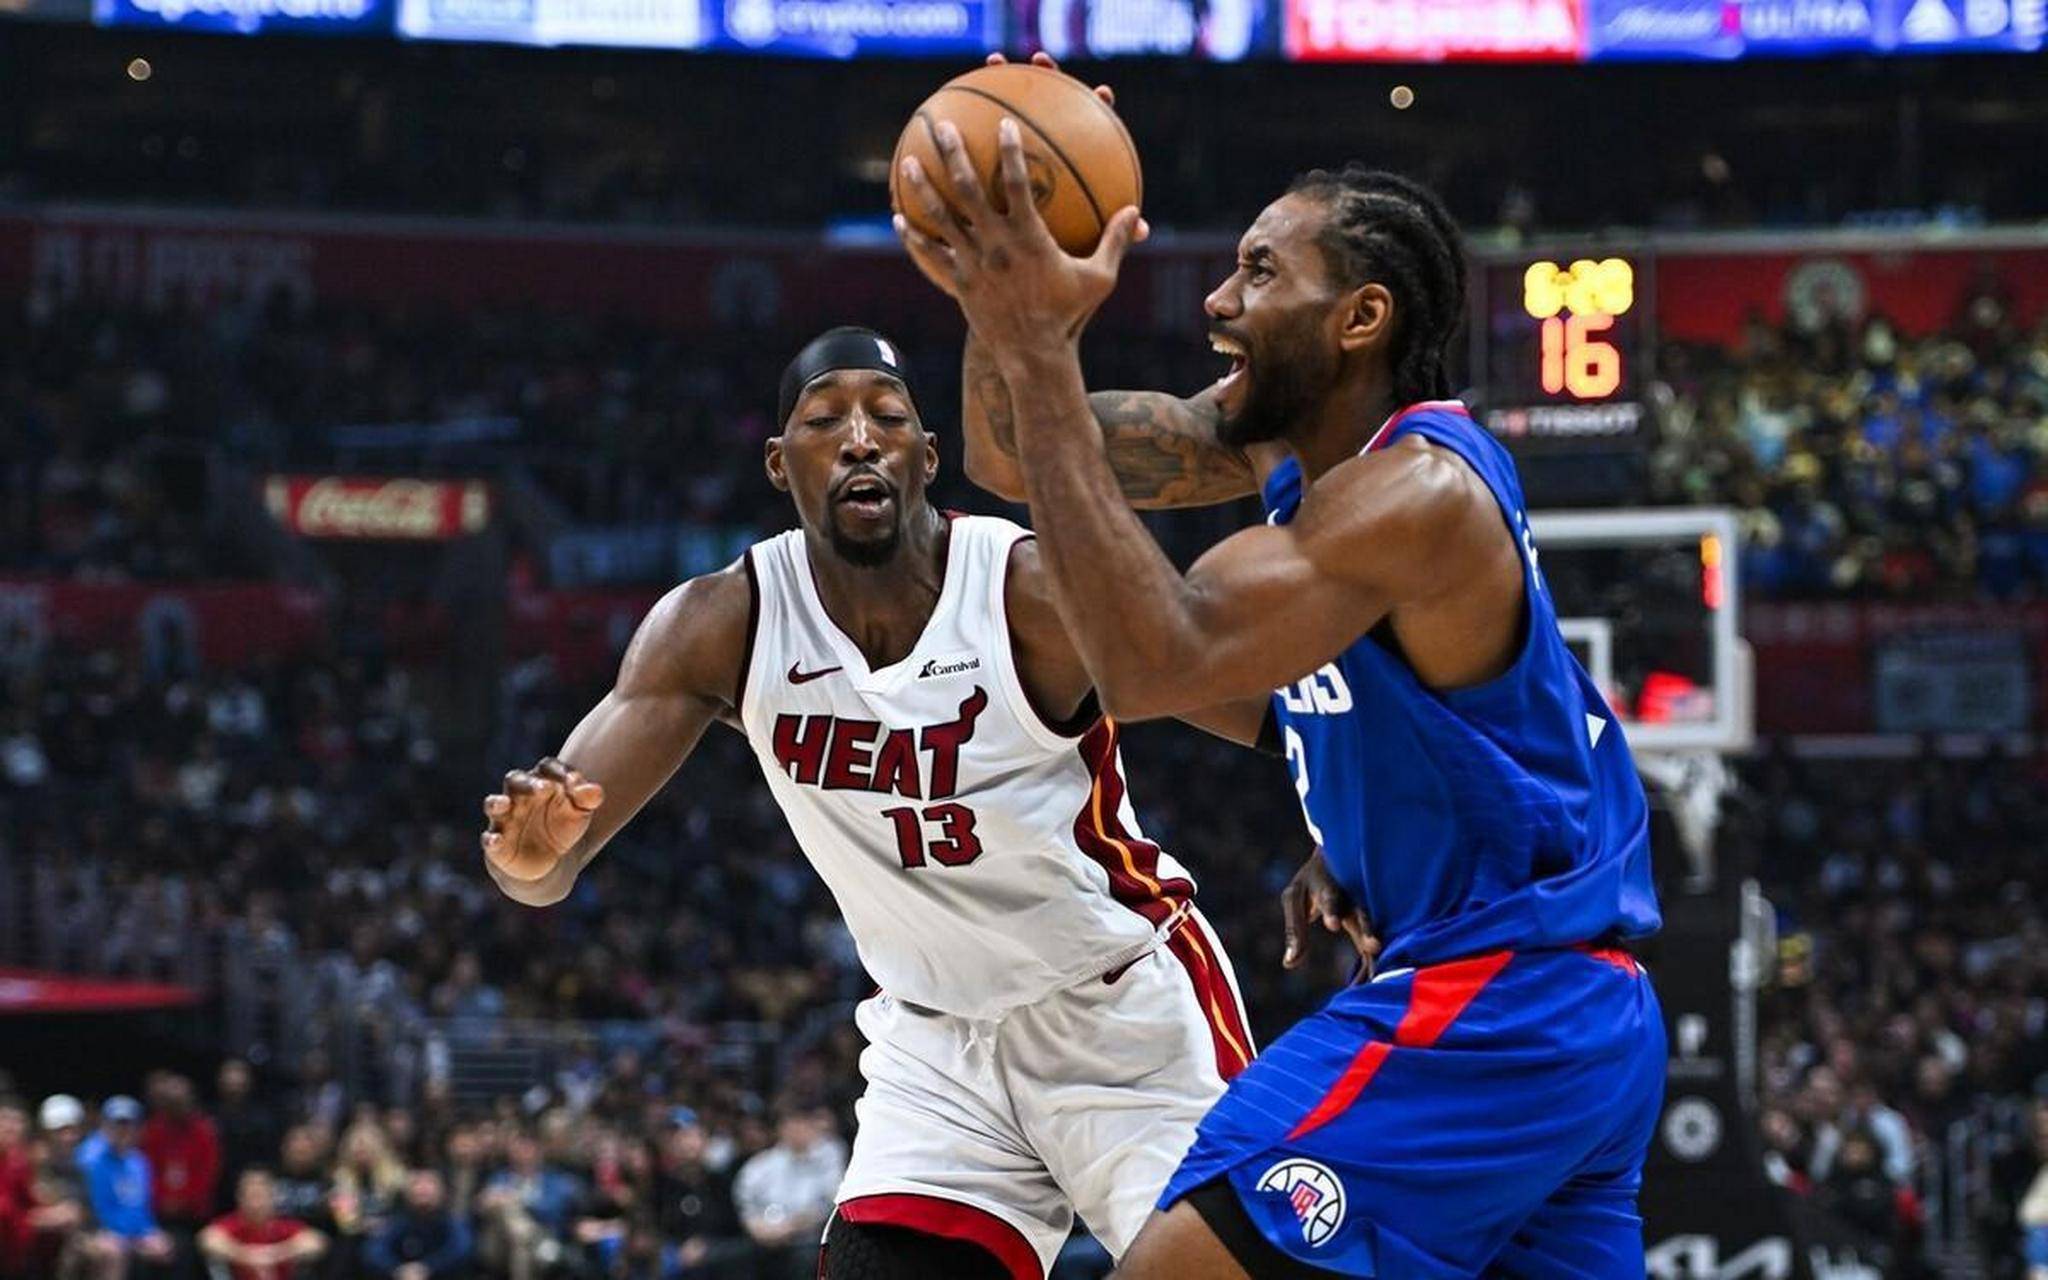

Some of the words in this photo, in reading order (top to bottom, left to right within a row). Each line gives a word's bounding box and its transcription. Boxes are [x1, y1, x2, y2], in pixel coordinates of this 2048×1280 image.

[1541, 314, 1621, 398] 16
[931, 658, 981, 677] Carnival
[772, 684, 988, 801] HEAT
[880, 802, 983, 869] 13
